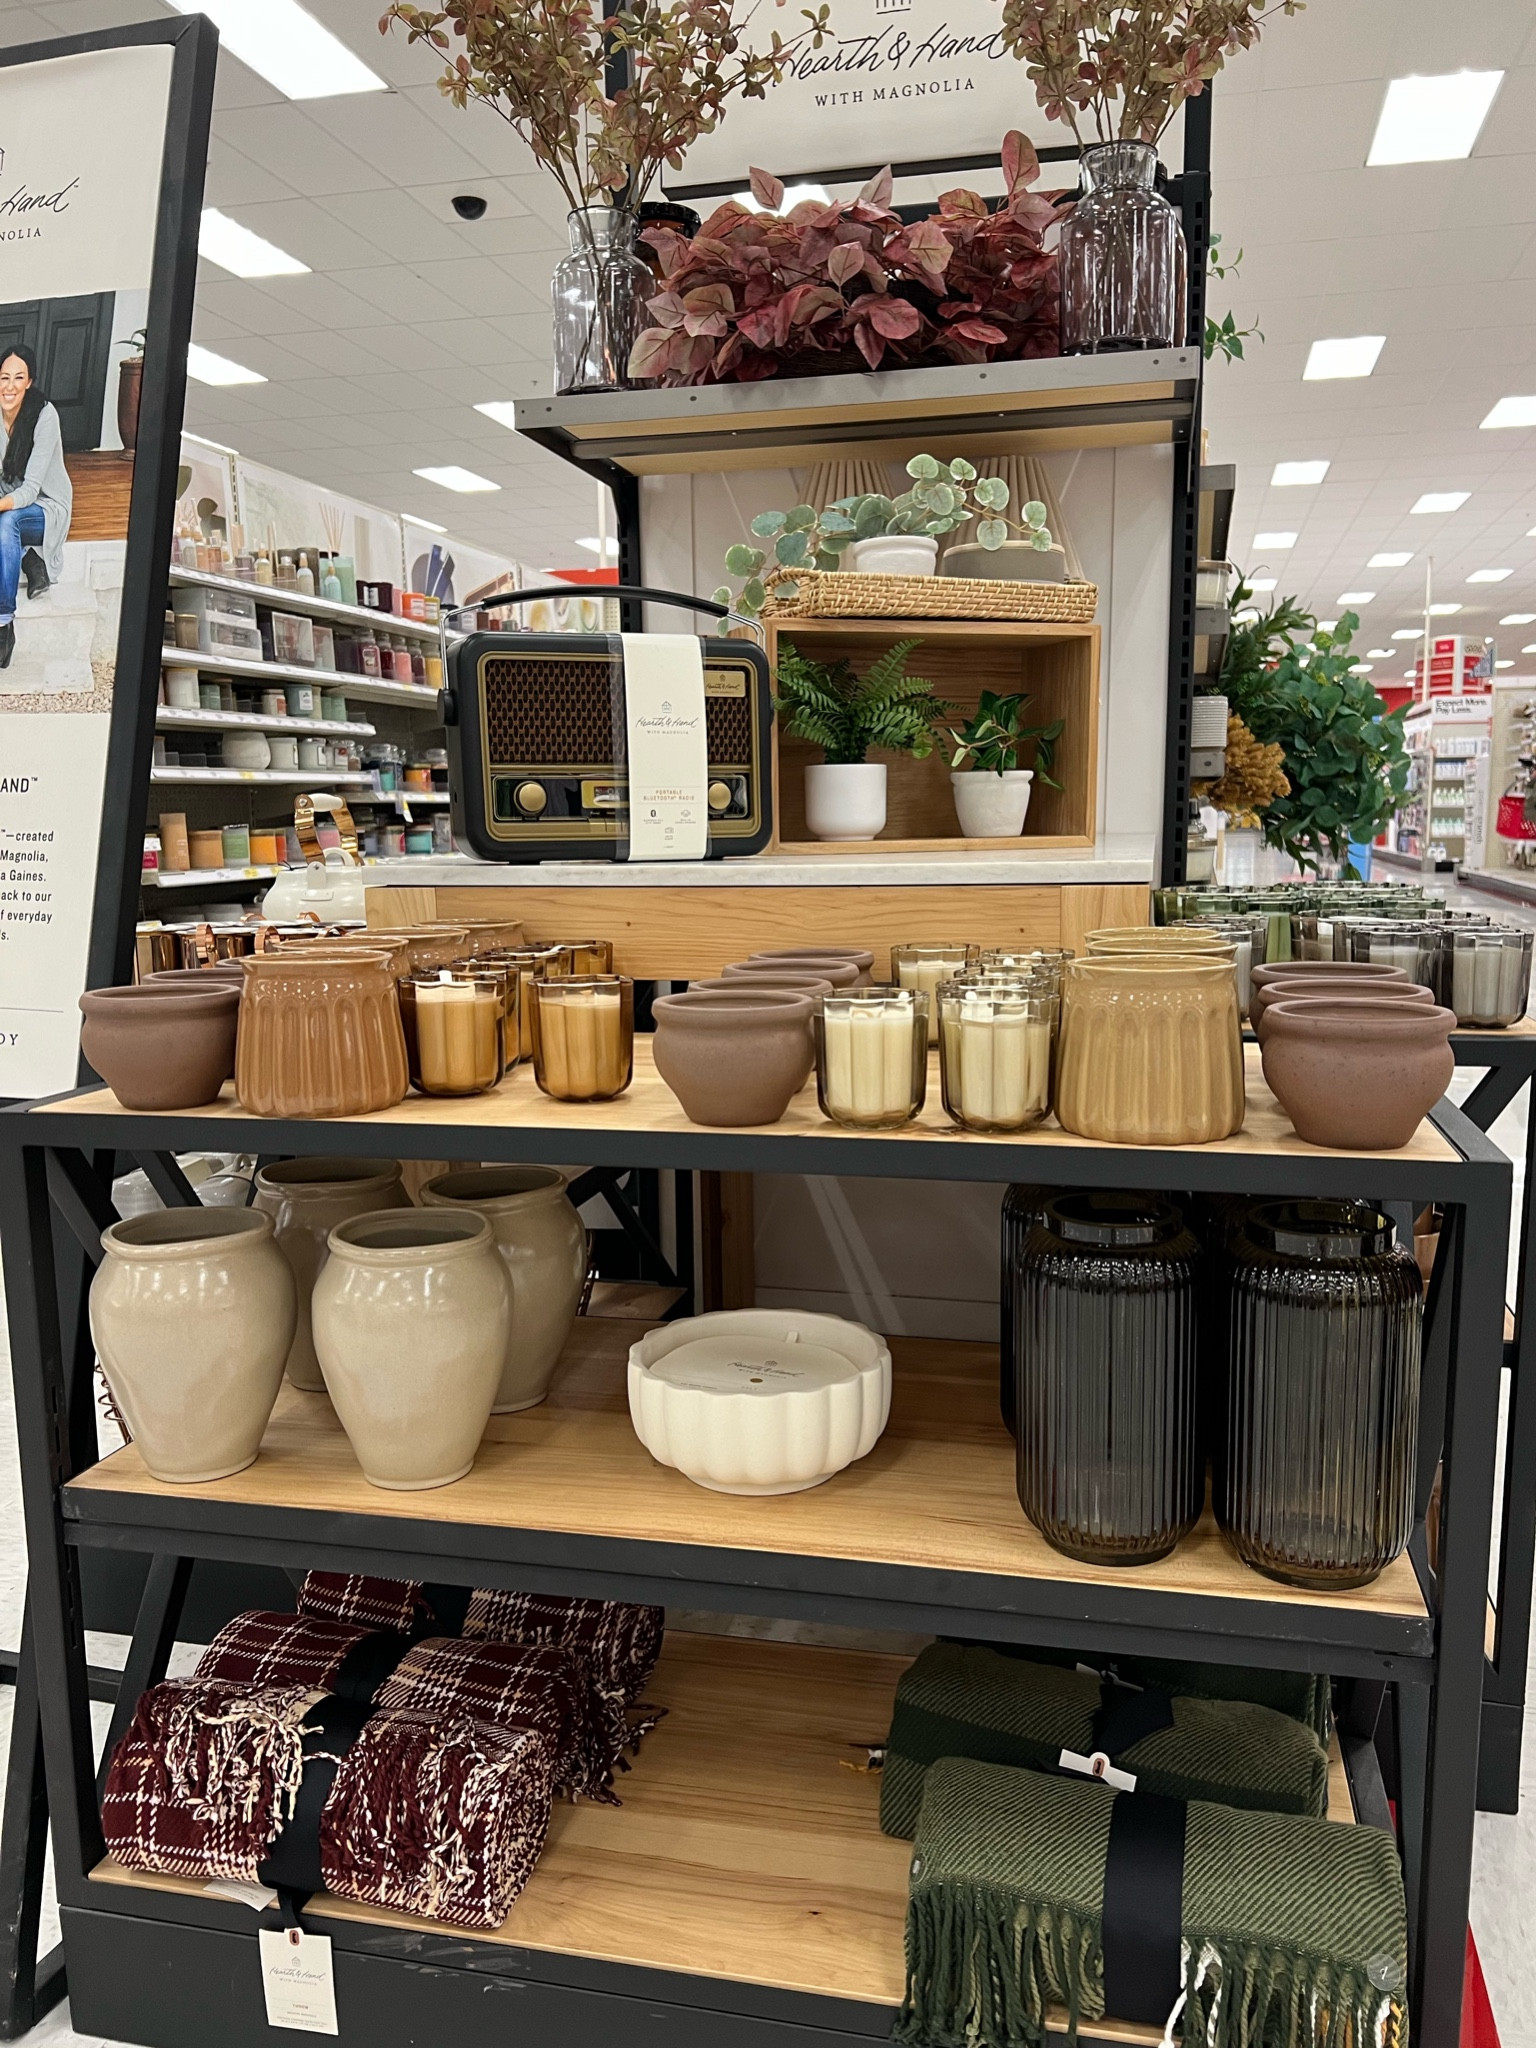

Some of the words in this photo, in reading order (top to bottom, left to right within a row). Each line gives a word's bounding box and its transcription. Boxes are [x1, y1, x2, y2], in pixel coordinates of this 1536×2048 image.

[772, 24, 894, 88] Hearth
[888, 31, 911, 71] &
[909, 23, 1008, 69] Hand
[815, 91, 864, 107] WITH
[872, 78, 975, 101] MAGNOLIA
[635, 715, 665, 728] Hearth
[671, 717, 699, 728] Hand
[0, 849, 49, 864] Magnolia,
[9, 869, 46, 882] Gaines.
[1, 889, 18, 901] ack
[22, 891, 32, 901] to
[34, 892, 52, 902] our
[7, 910, 53, 924] everyday
[269, 1966, 297, 1977] Hearth
